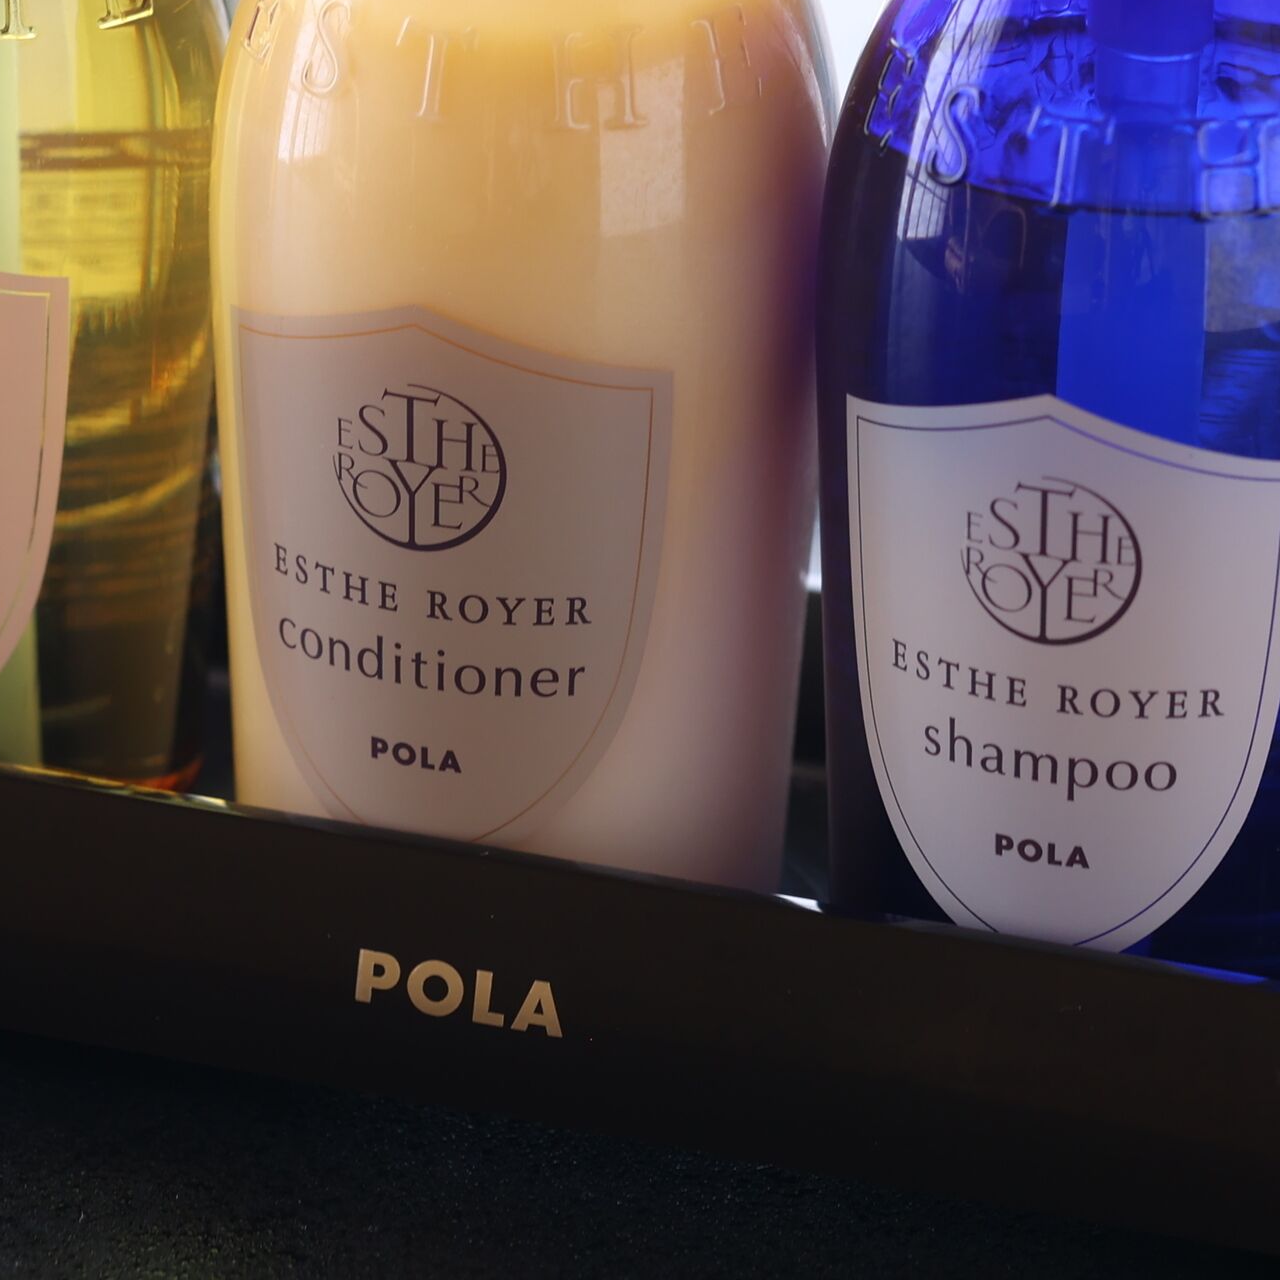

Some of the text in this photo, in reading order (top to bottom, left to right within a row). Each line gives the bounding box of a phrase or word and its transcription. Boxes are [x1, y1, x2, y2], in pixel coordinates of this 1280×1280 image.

[273, 542, 592, 626] ESTHE ROYER
[278, 616, 586, 699] conditioner
[892, 638, 1225, 720] ESTHE ROYER
[370, 735, 462, 773] POLA
[923, 716, 1179, 802] shampoo
[994, 832, 1090, 870] POLA
[355, 948, 563, 1038] POLA
